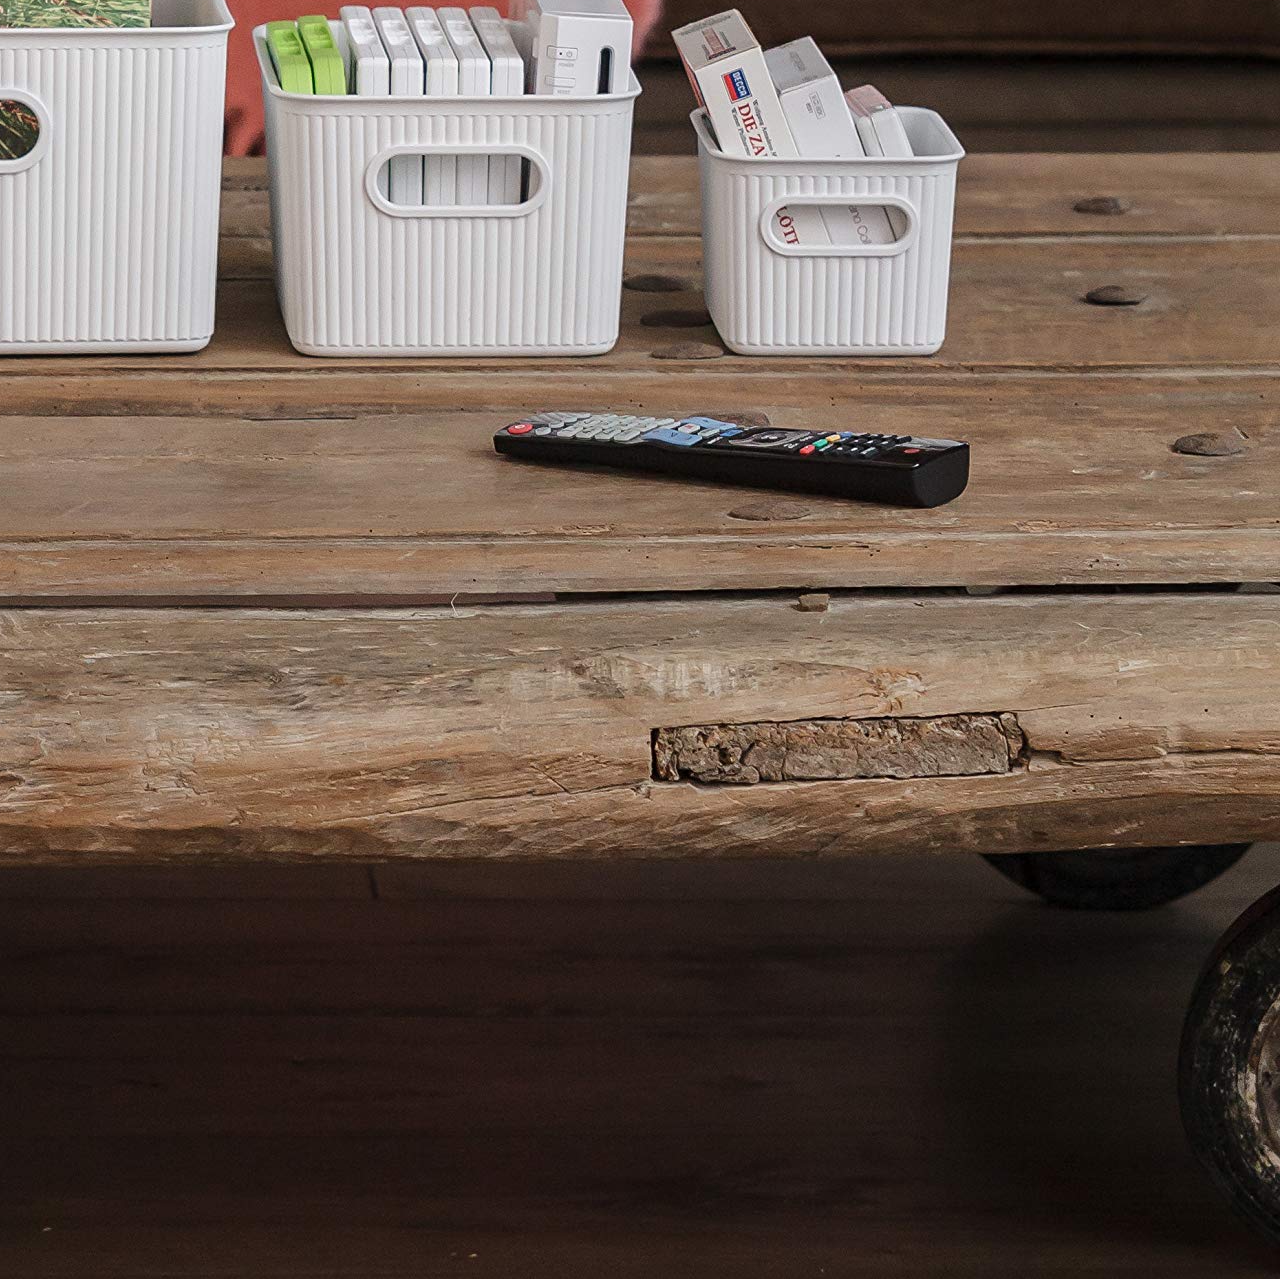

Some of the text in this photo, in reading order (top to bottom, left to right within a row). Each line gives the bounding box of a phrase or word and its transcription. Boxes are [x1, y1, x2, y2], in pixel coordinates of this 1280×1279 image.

[733, 72, 747, 96] DECCA
[738, 103, 768, 156] DIE ZA
